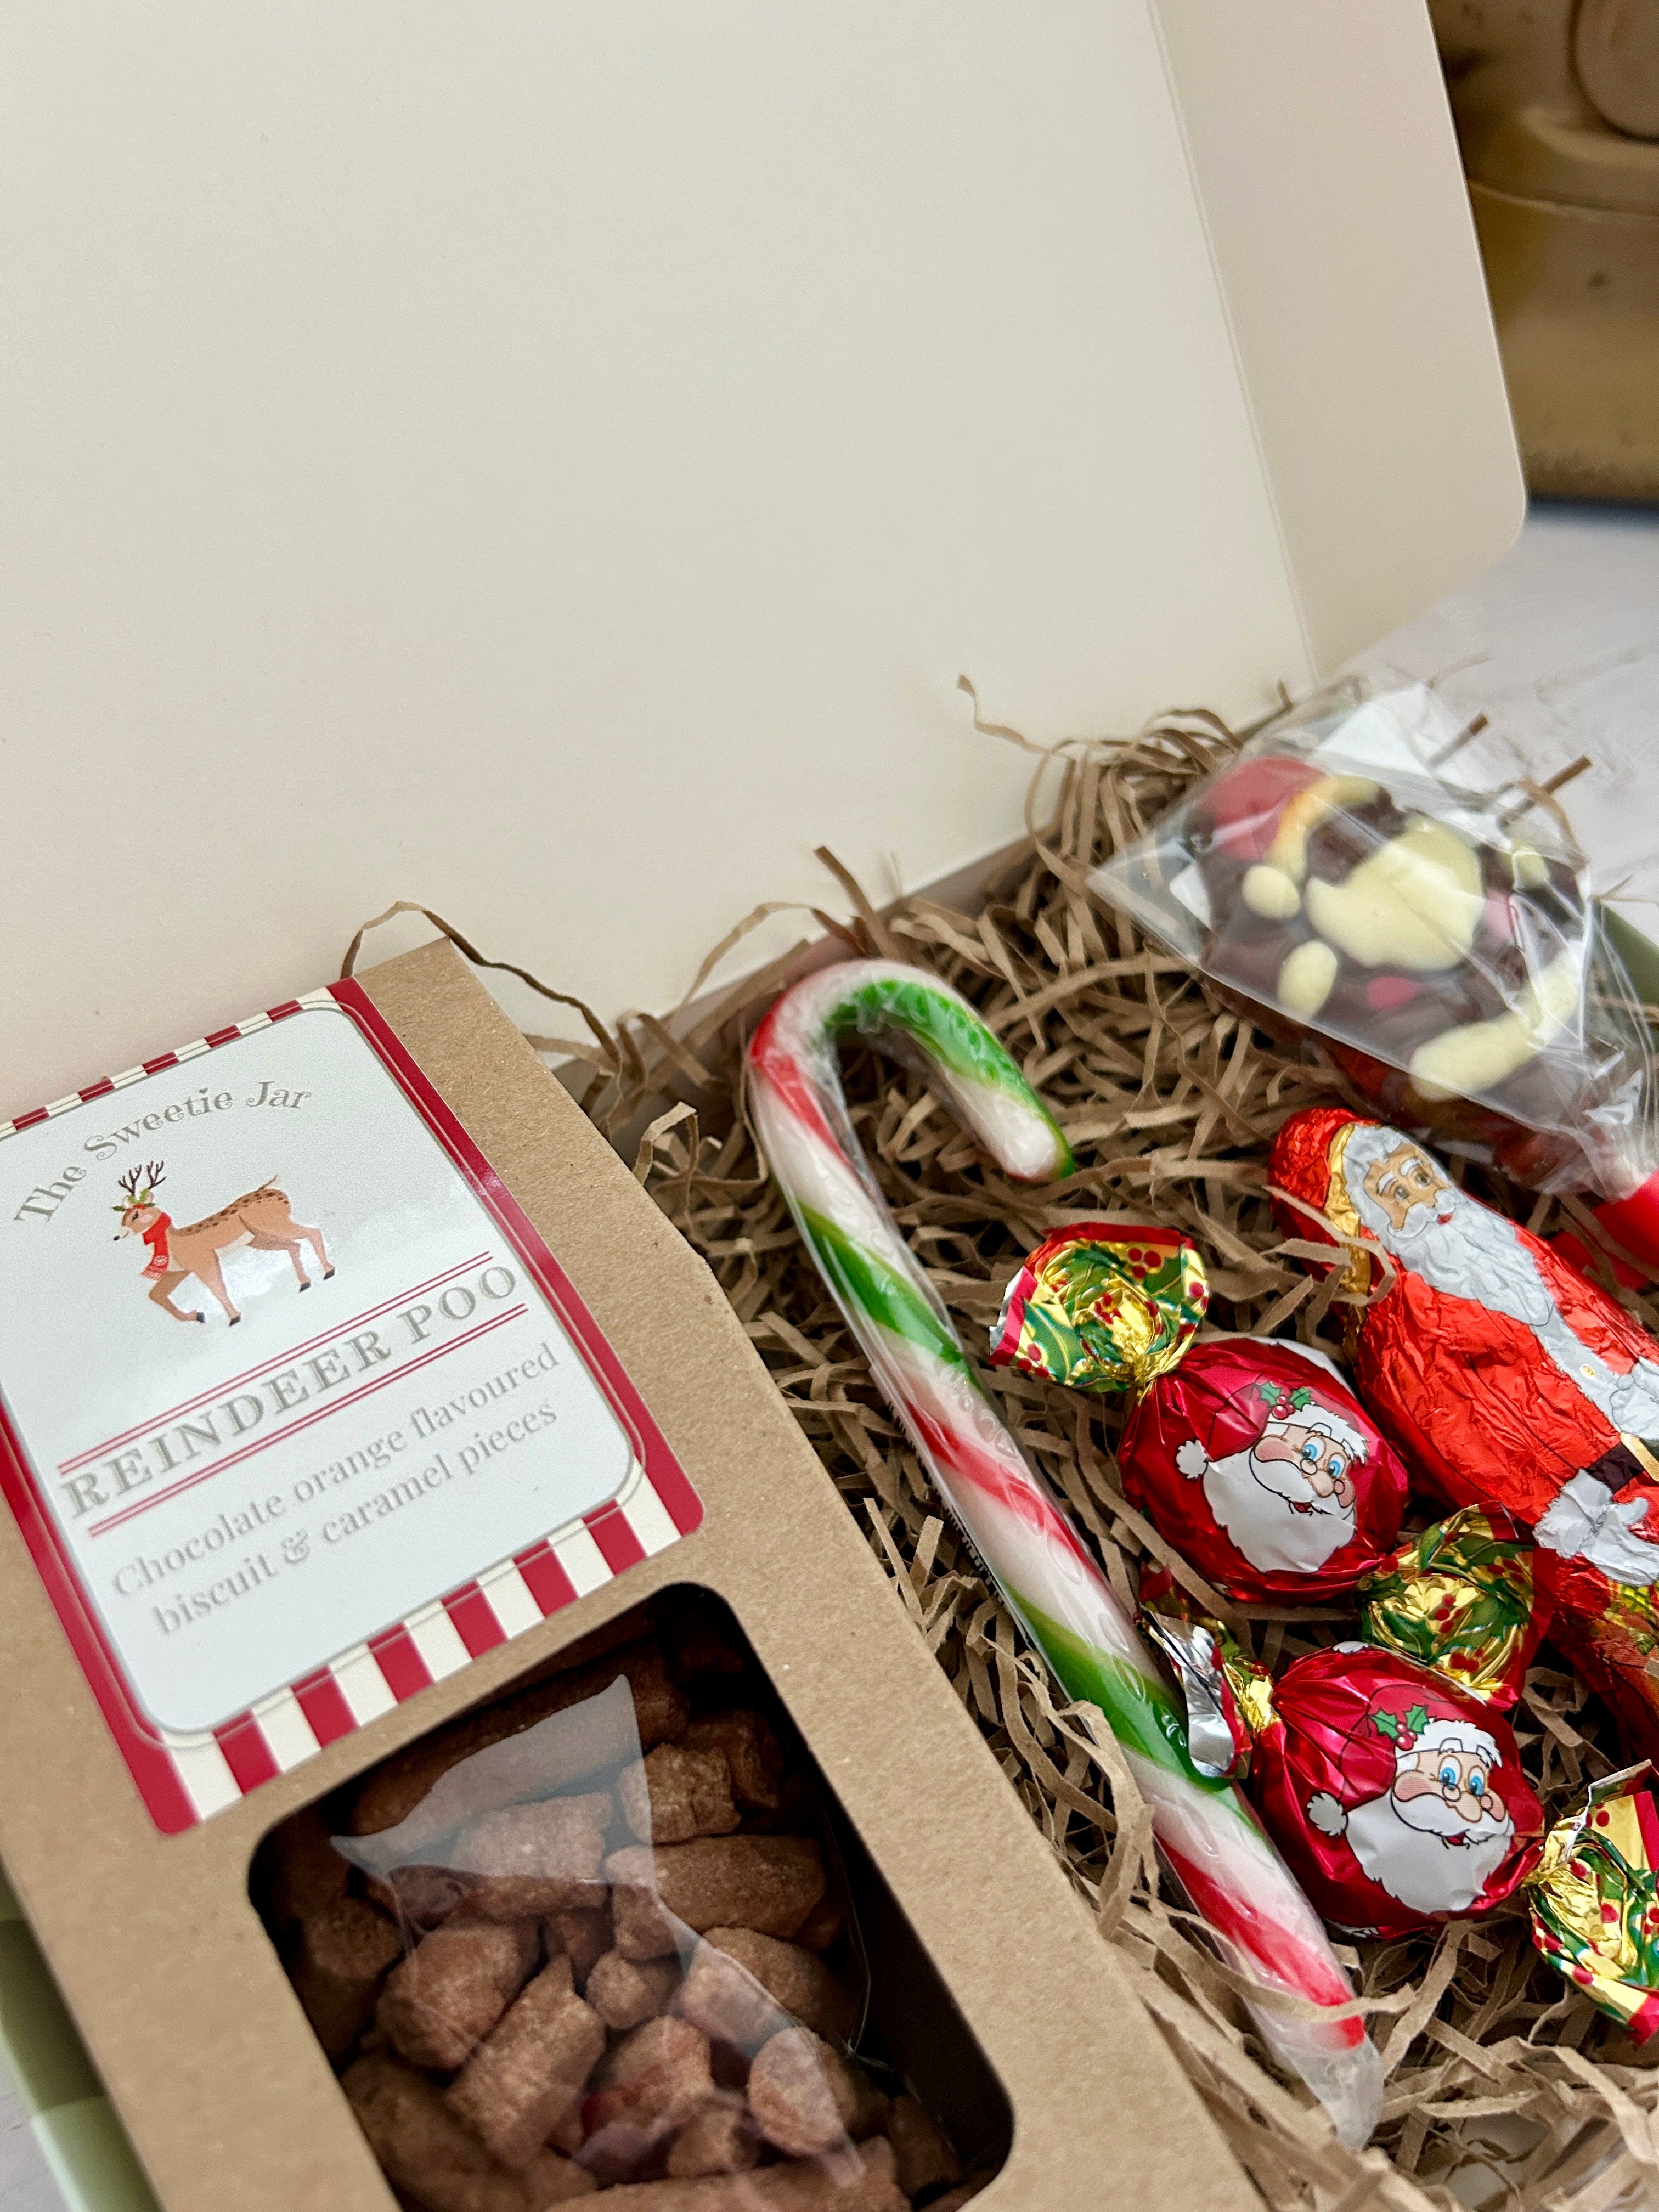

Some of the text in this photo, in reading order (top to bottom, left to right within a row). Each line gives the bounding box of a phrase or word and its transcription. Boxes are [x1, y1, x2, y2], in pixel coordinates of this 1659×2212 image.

[14, 1080, 312, 1222] The Sweetie Jar
[60, 1266, 516, 1519] REINDEER POO
[112, 1342, 560, 1596] Chocolate orange flavoured
[150, 1400, 557, 1637] biscuit & caramel pieces
